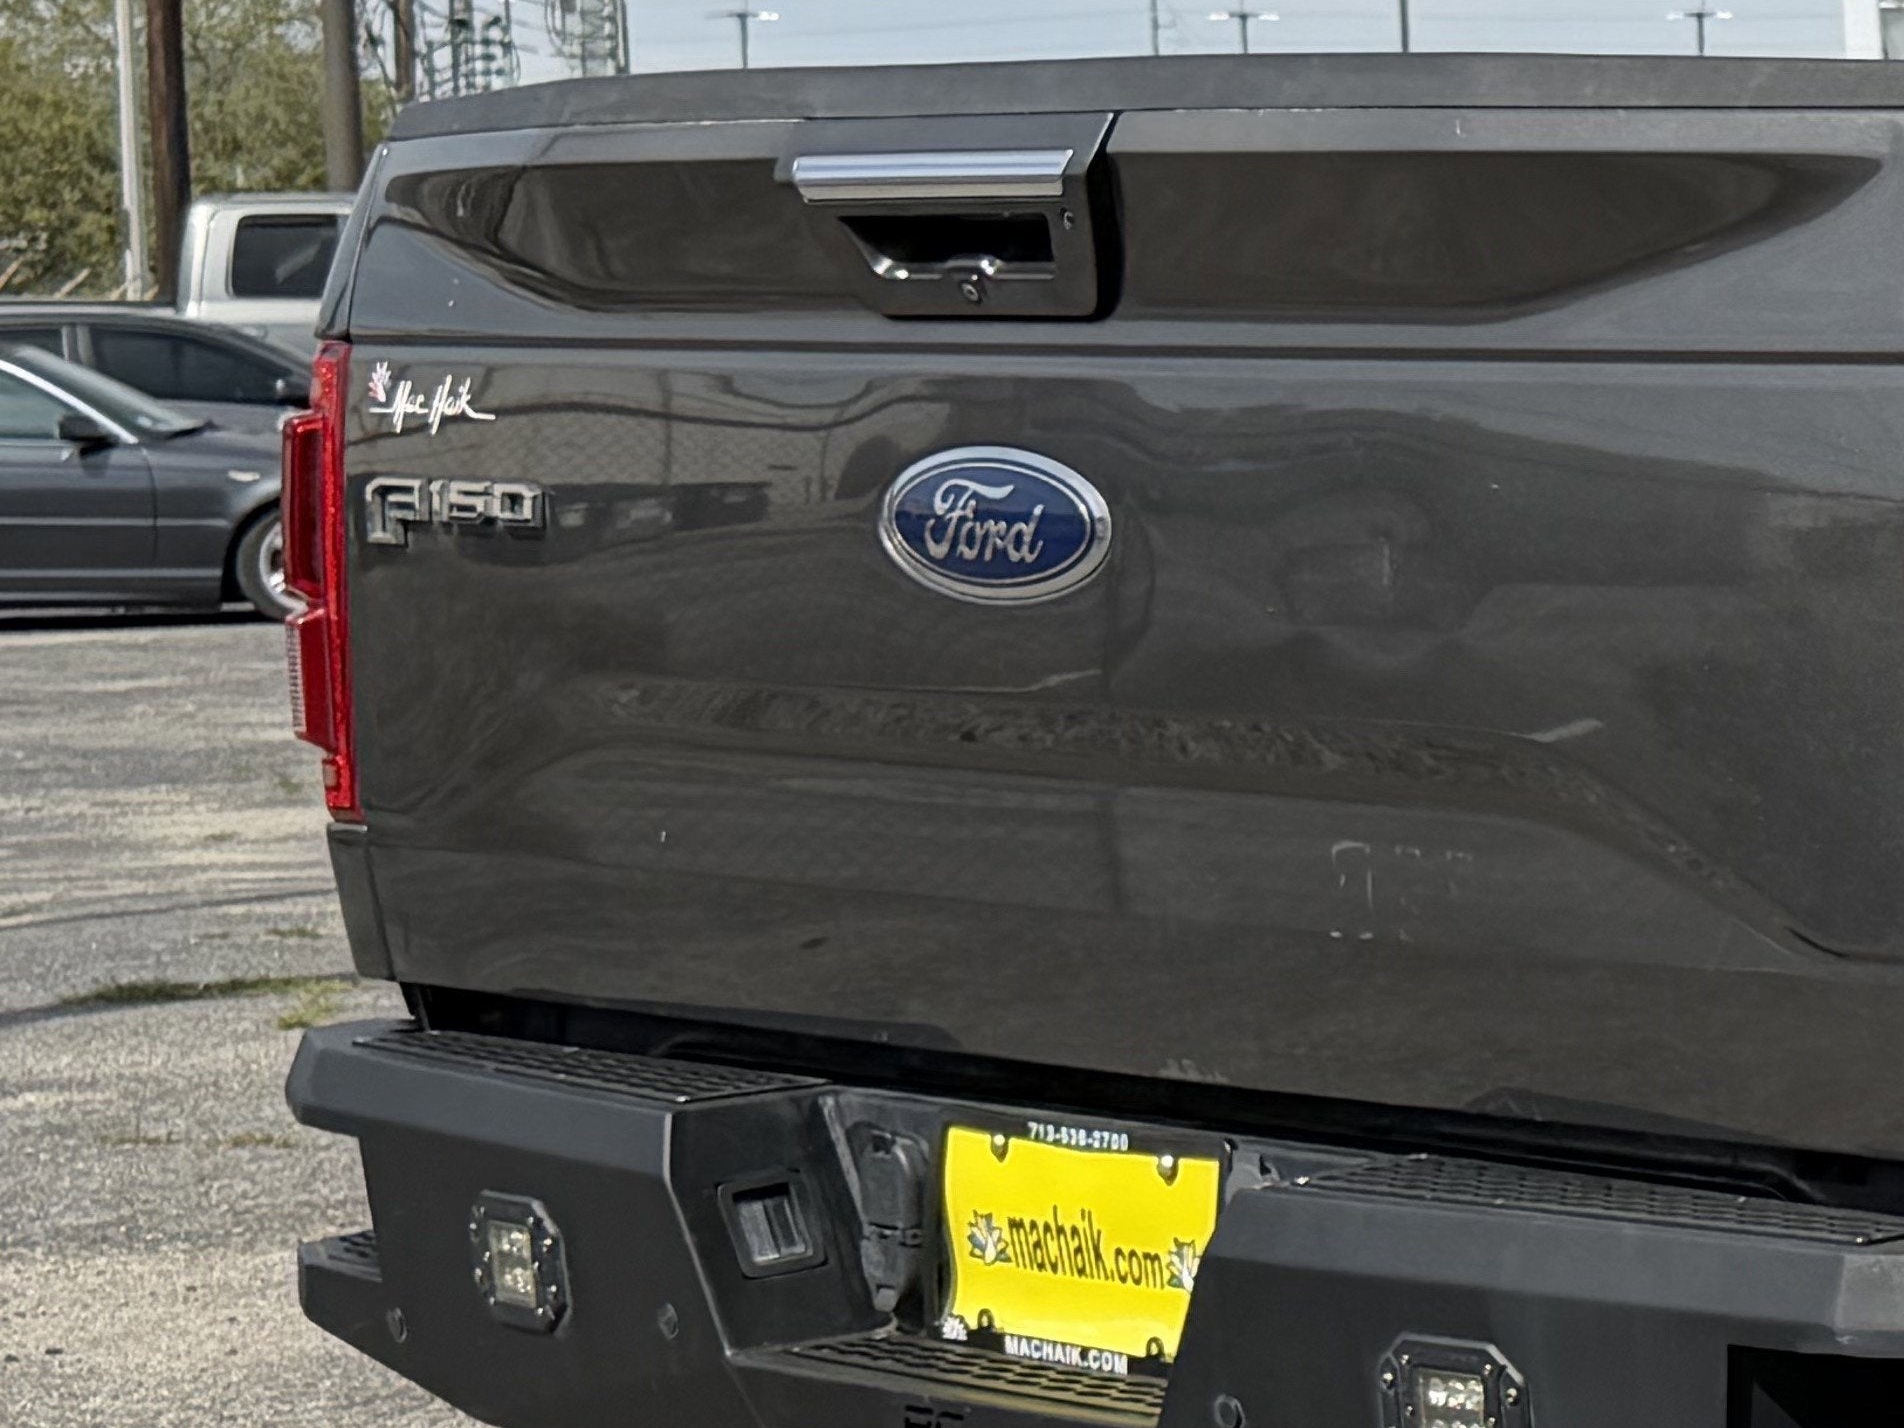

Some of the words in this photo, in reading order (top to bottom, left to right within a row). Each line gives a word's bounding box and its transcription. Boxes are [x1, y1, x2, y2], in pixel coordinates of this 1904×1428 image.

[922, 477, 1044, 565] Ford
[1006, 1205, 1165, 1290] machaik.com
[1004, 1334, 1128, 1375] MACHAIK.COM
